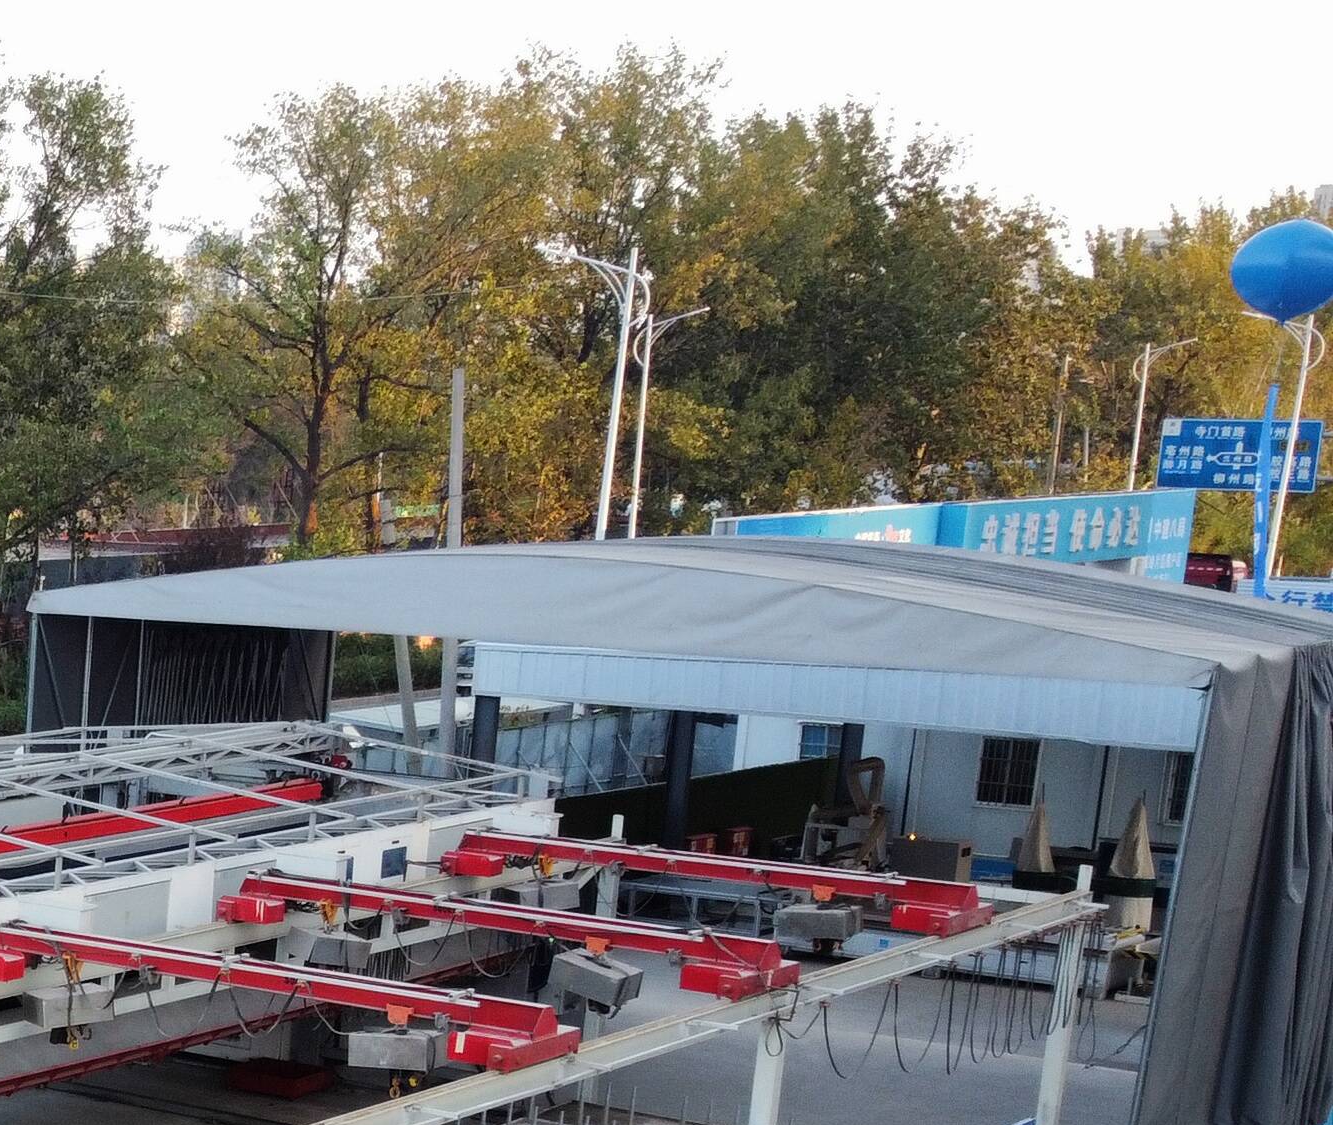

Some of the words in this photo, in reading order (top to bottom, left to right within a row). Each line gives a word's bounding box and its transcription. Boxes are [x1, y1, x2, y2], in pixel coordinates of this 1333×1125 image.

[980, 509, 1060, 556] 忠诚担当
[1069, 506, 1141, 552] 使命必达
